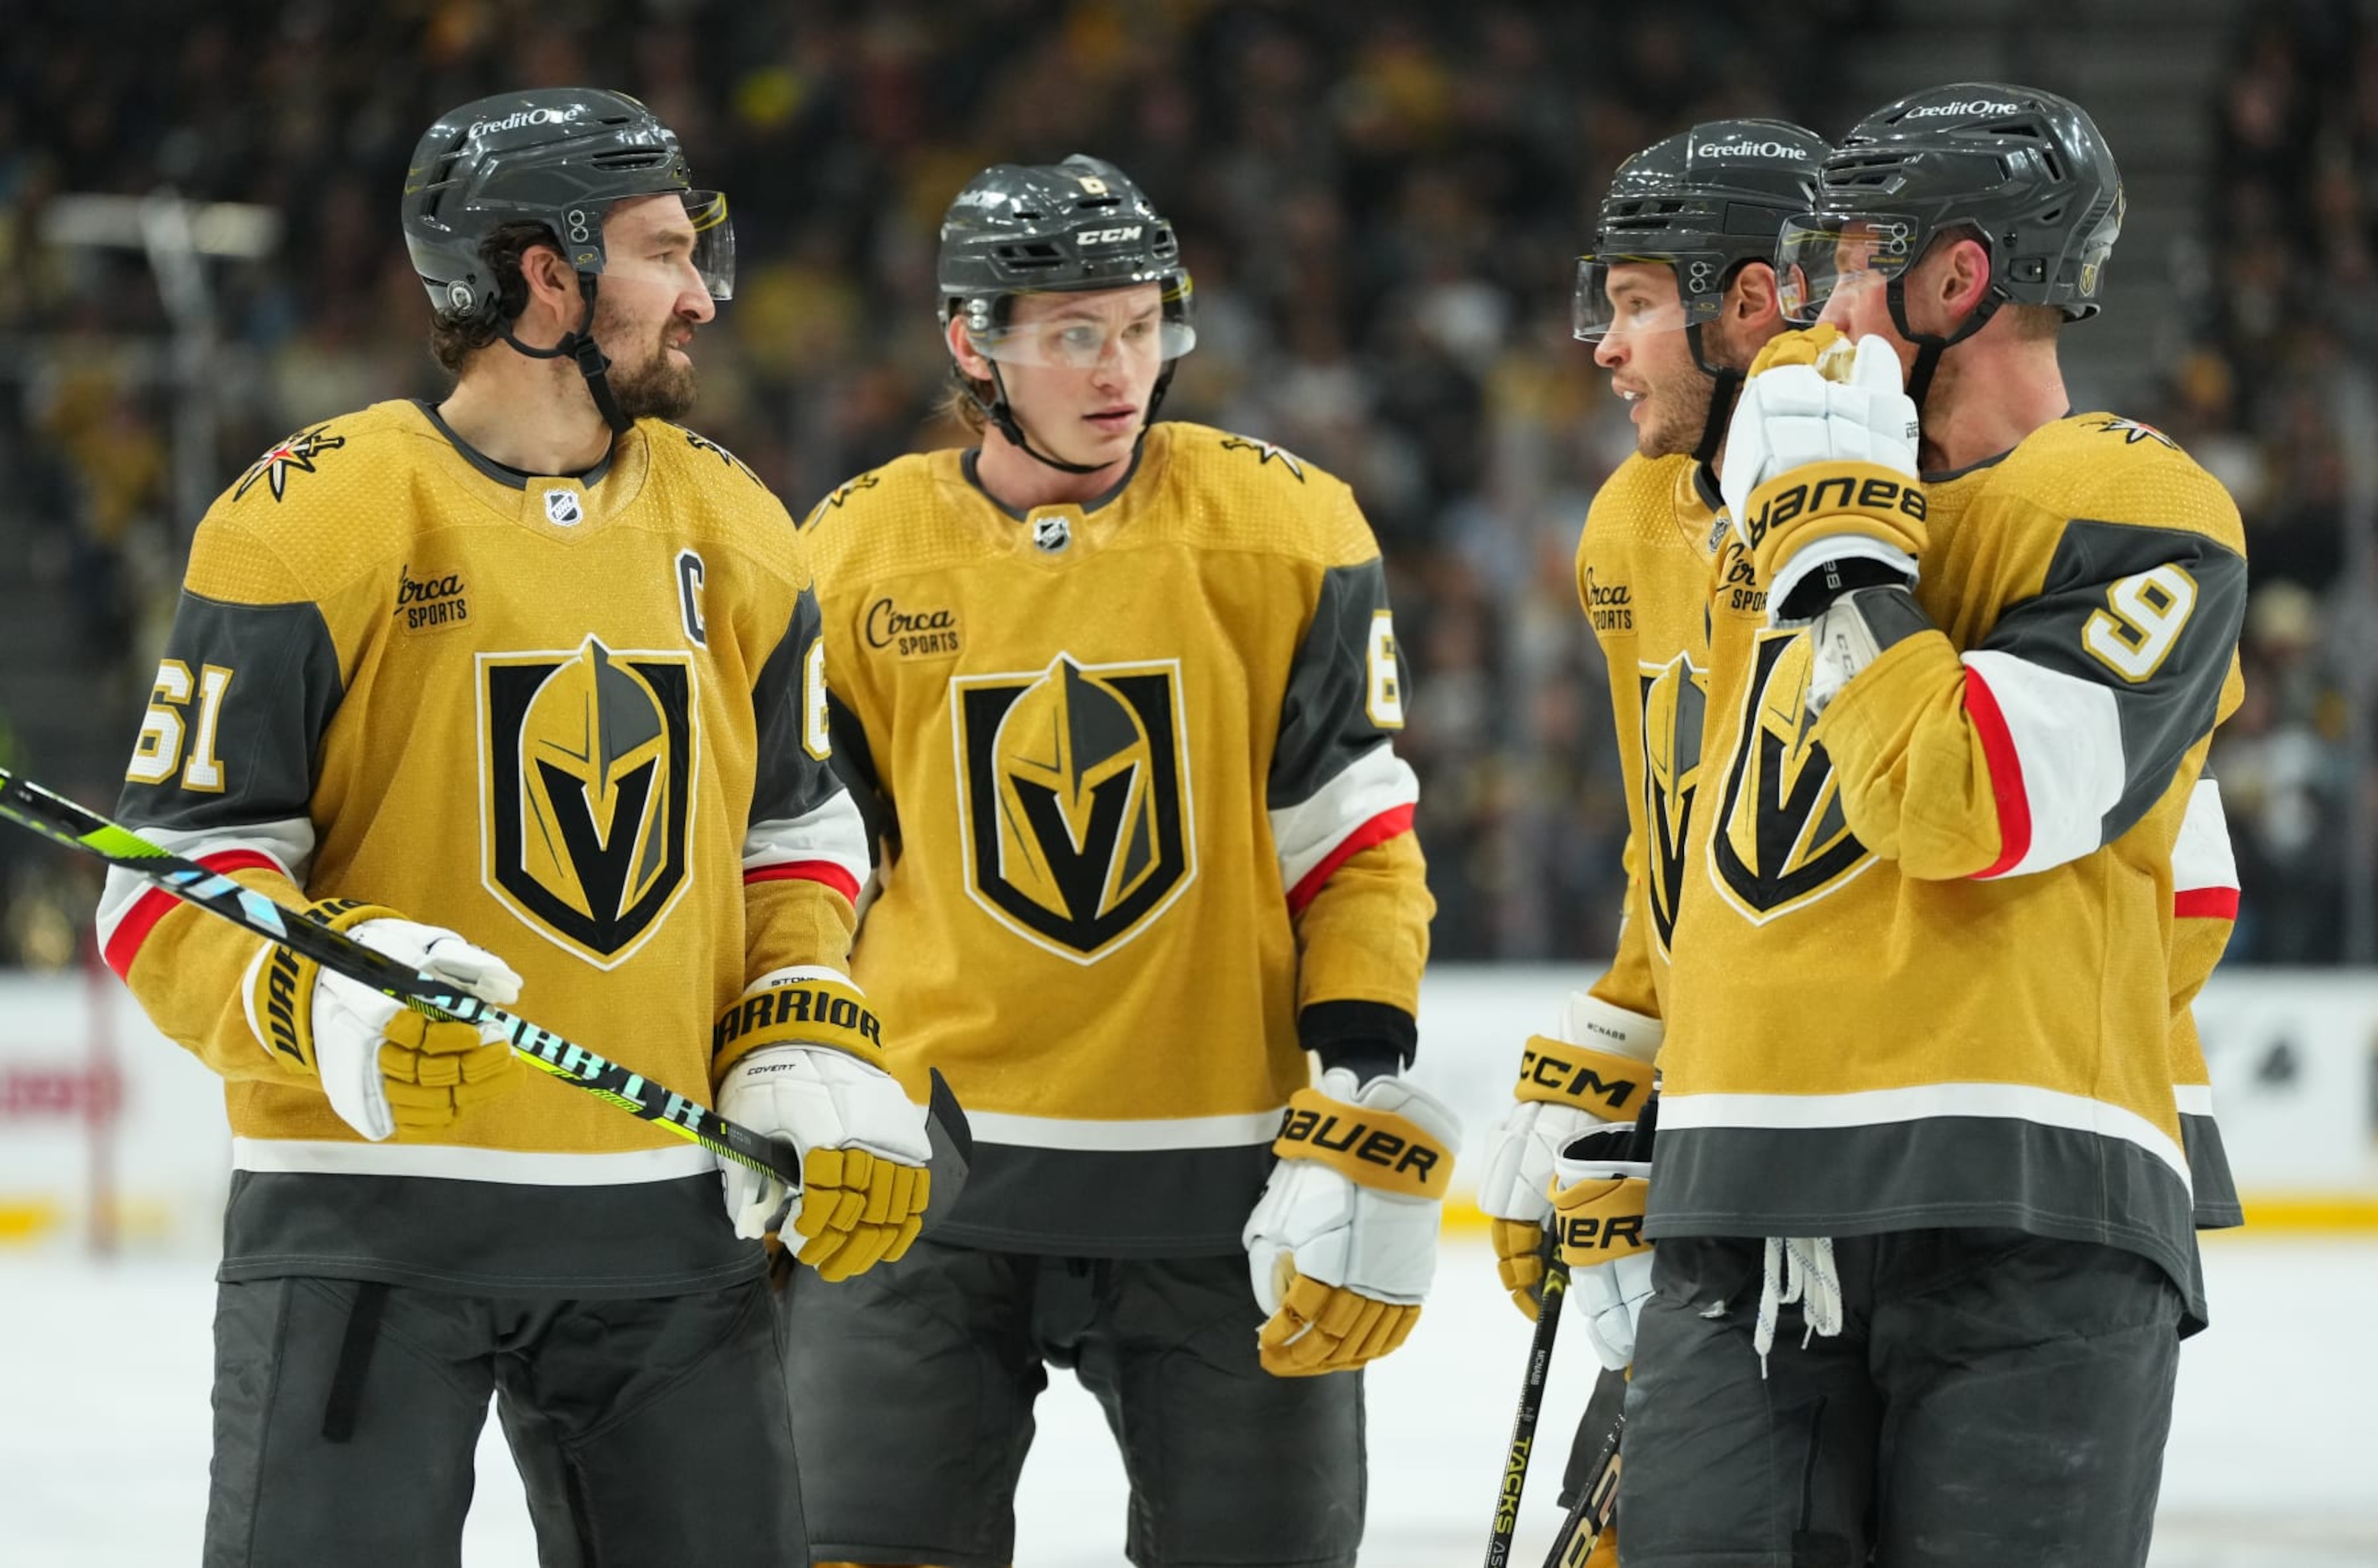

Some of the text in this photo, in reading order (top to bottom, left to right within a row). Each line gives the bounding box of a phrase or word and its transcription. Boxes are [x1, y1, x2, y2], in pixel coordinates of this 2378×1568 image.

[1905, 100, 2018, 118] CreditOne
[1698, 141, 1808, 160] CreditOne
[1076, 225, 1142, 245] CCM
[408, 598, 466, 629] SPORTS
[674, 547, 708, 651] C
[866, 598, 956, 649] Circa
[2081, 562, 2199, 684] 9
[899, 630, 959, 656] SPORTS
[125, 658, 234, 794] 61
[747, 1063, 797, 1076] COVERT
[1496, 1436, 1533, 1535] TACKS
